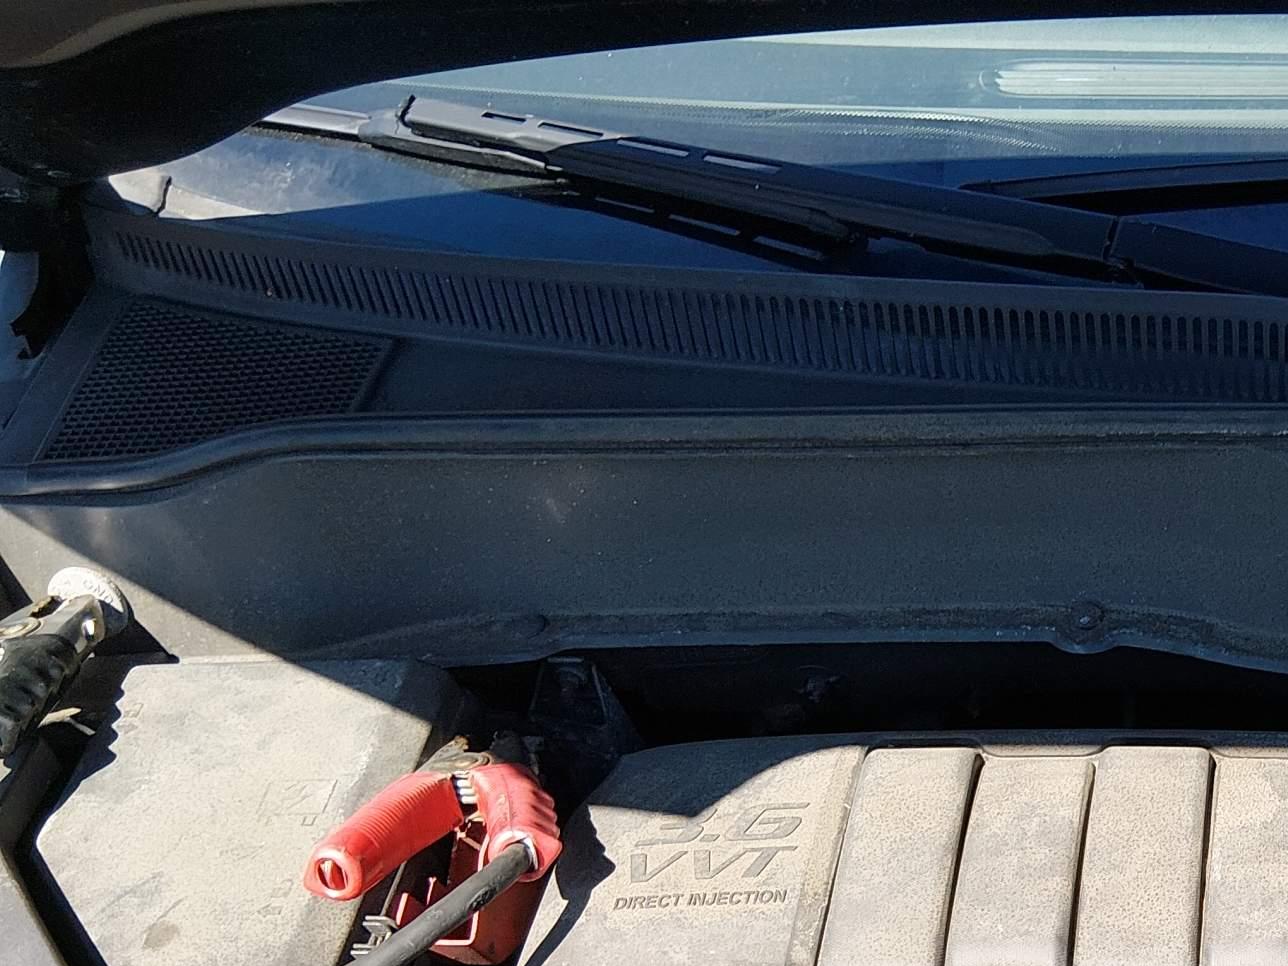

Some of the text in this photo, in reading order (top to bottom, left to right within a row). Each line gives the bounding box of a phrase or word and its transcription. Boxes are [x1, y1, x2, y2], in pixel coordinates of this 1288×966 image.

[630, 846, 799, 883] VVT
[613, 889, 788, 911] DIRECT INJECTION
